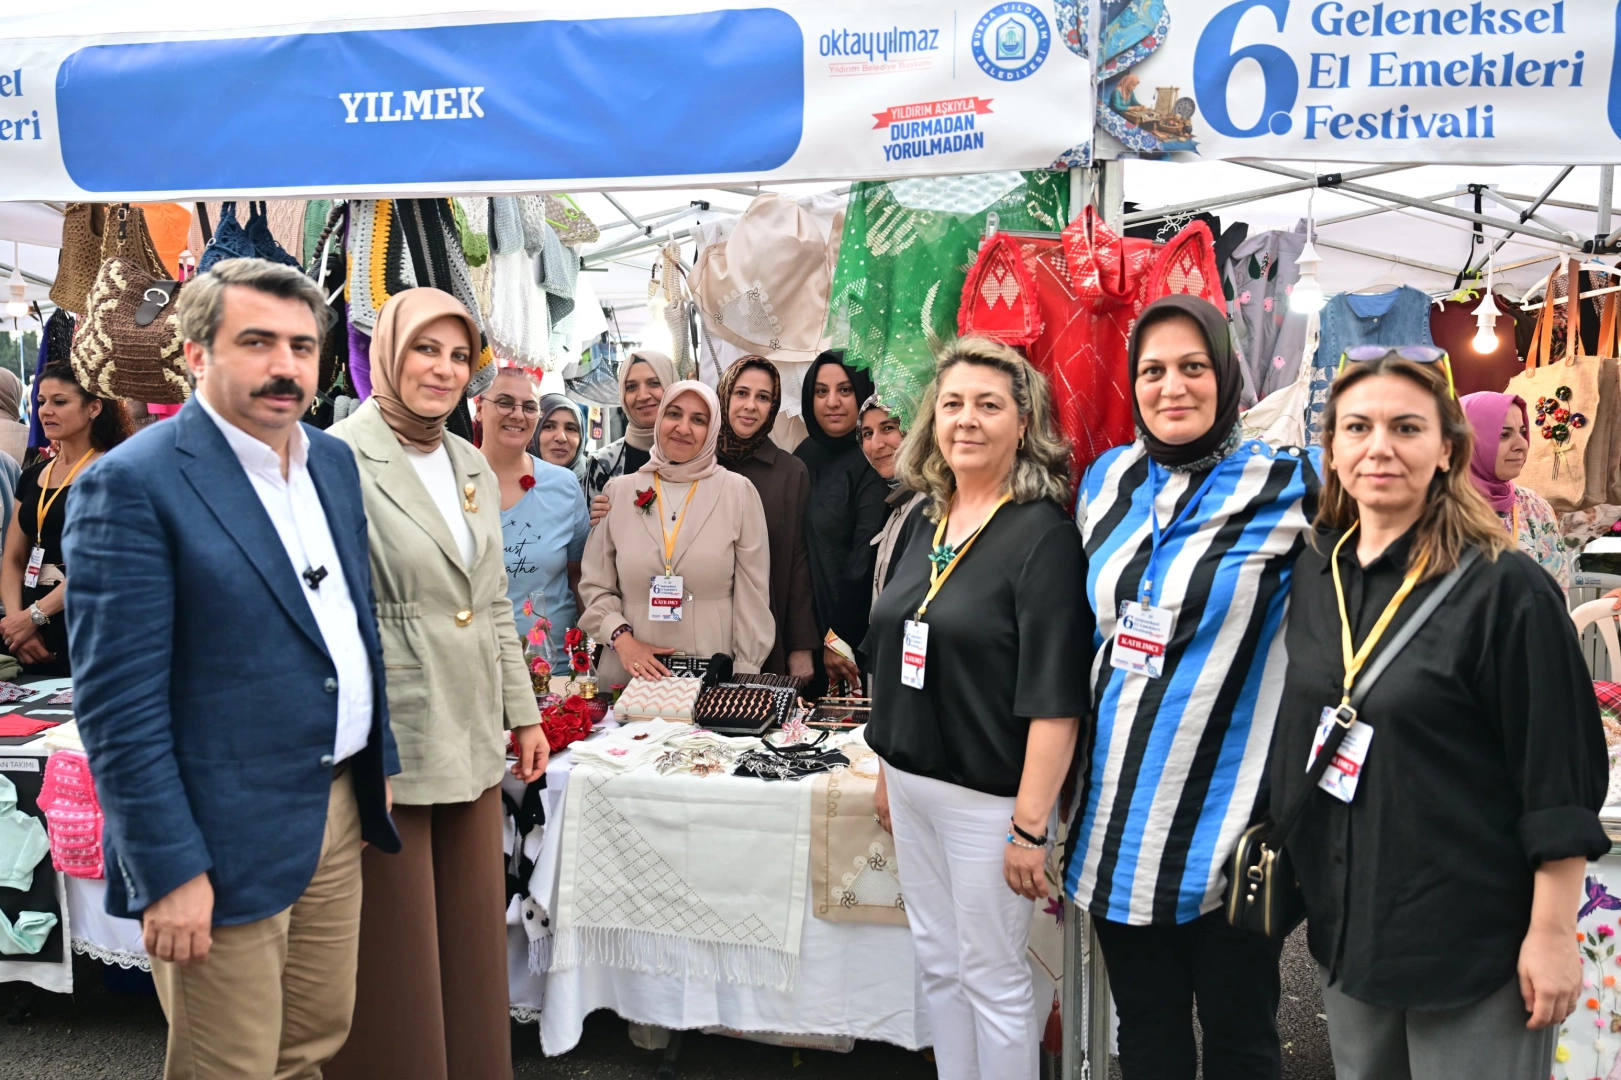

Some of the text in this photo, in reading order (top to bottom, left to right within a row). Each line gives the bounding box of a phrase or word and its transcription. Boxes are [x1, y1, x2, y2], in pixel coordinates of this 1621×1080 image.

[973, 4, 1048, 47] BURSA YILDIRIM
[1311, 0, 1566, 37] Geleneksel
[0, 68, 24, 97] el
[862, 63, 897, 73] Belediye
[1307, 50, 1585, 89] El Emekleri
[339, 86, 485, 124] YILMEK
[891, 99, 975, 120] YILDIRIM AŞKIYLA
[0, 109, 42, 141] eri
[891, 113, 975, 142] DURMADAN
[1303, 104, 1496, 140] Festivali
[883, 131, 984, 162] YORULMADAN
[503, 538, 537, 557] ust
[505, 556, 540, 579] athe
[1121, 637, 1160, 653] KATILIMCI
